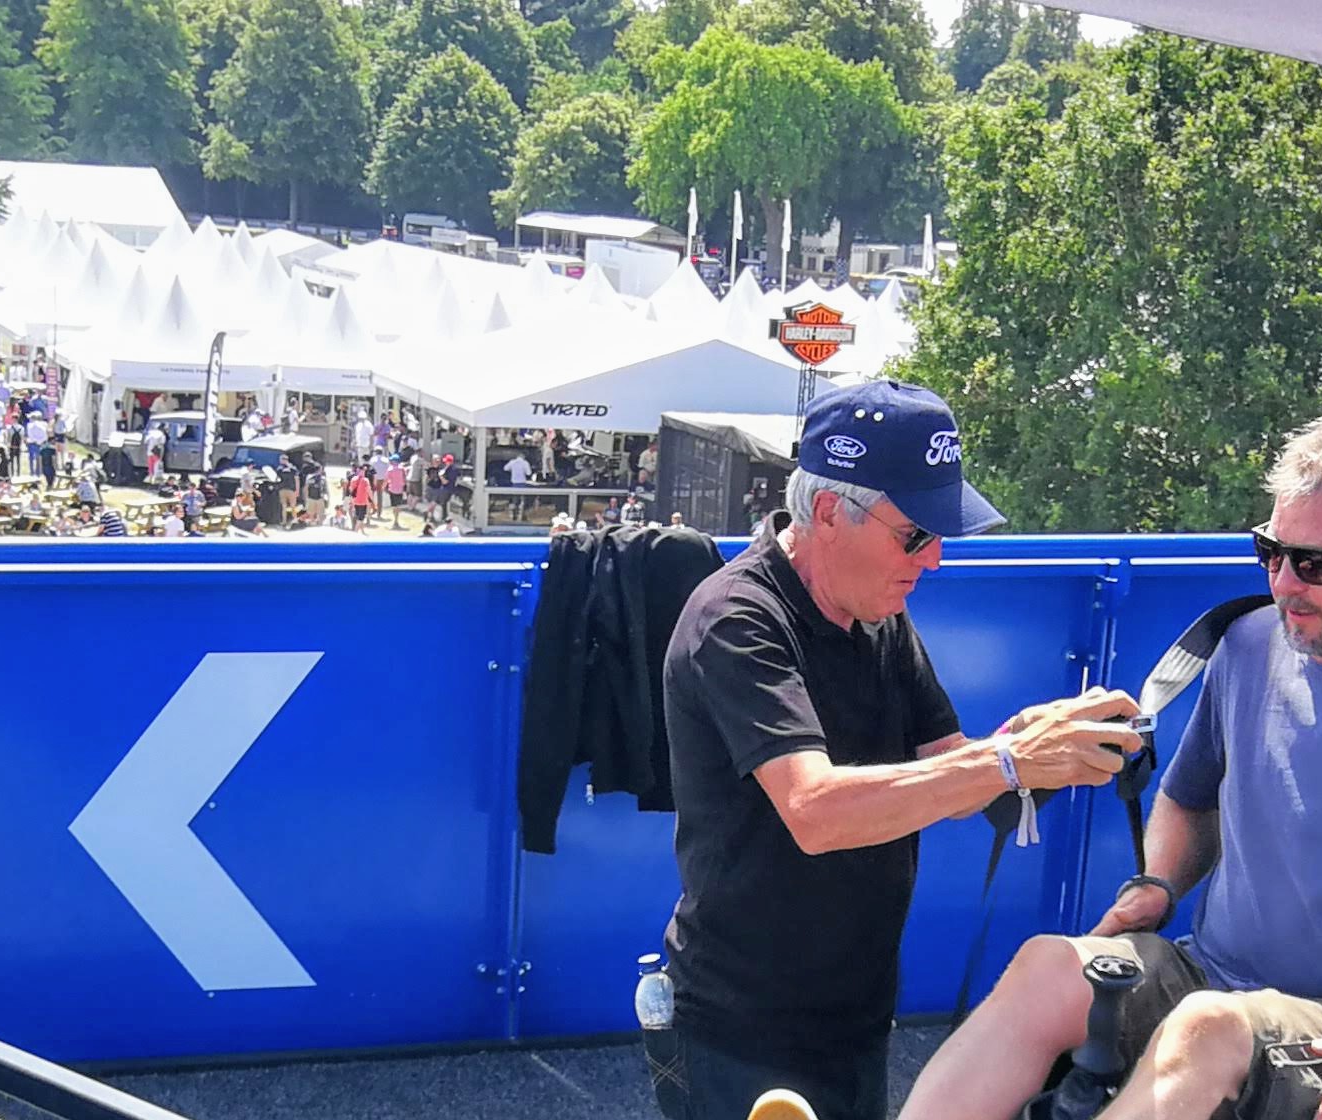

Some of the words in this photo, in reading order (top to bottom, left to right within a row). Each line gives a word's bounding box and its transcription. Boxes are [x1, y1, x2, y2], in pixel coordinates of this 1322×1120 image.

[801, 309, 839, 324] MOTOR
[797, 343, 836, 360] CYCLES
[531, 402, 609, 417] TWISTED
[829, 438, 860, 456] Ford
